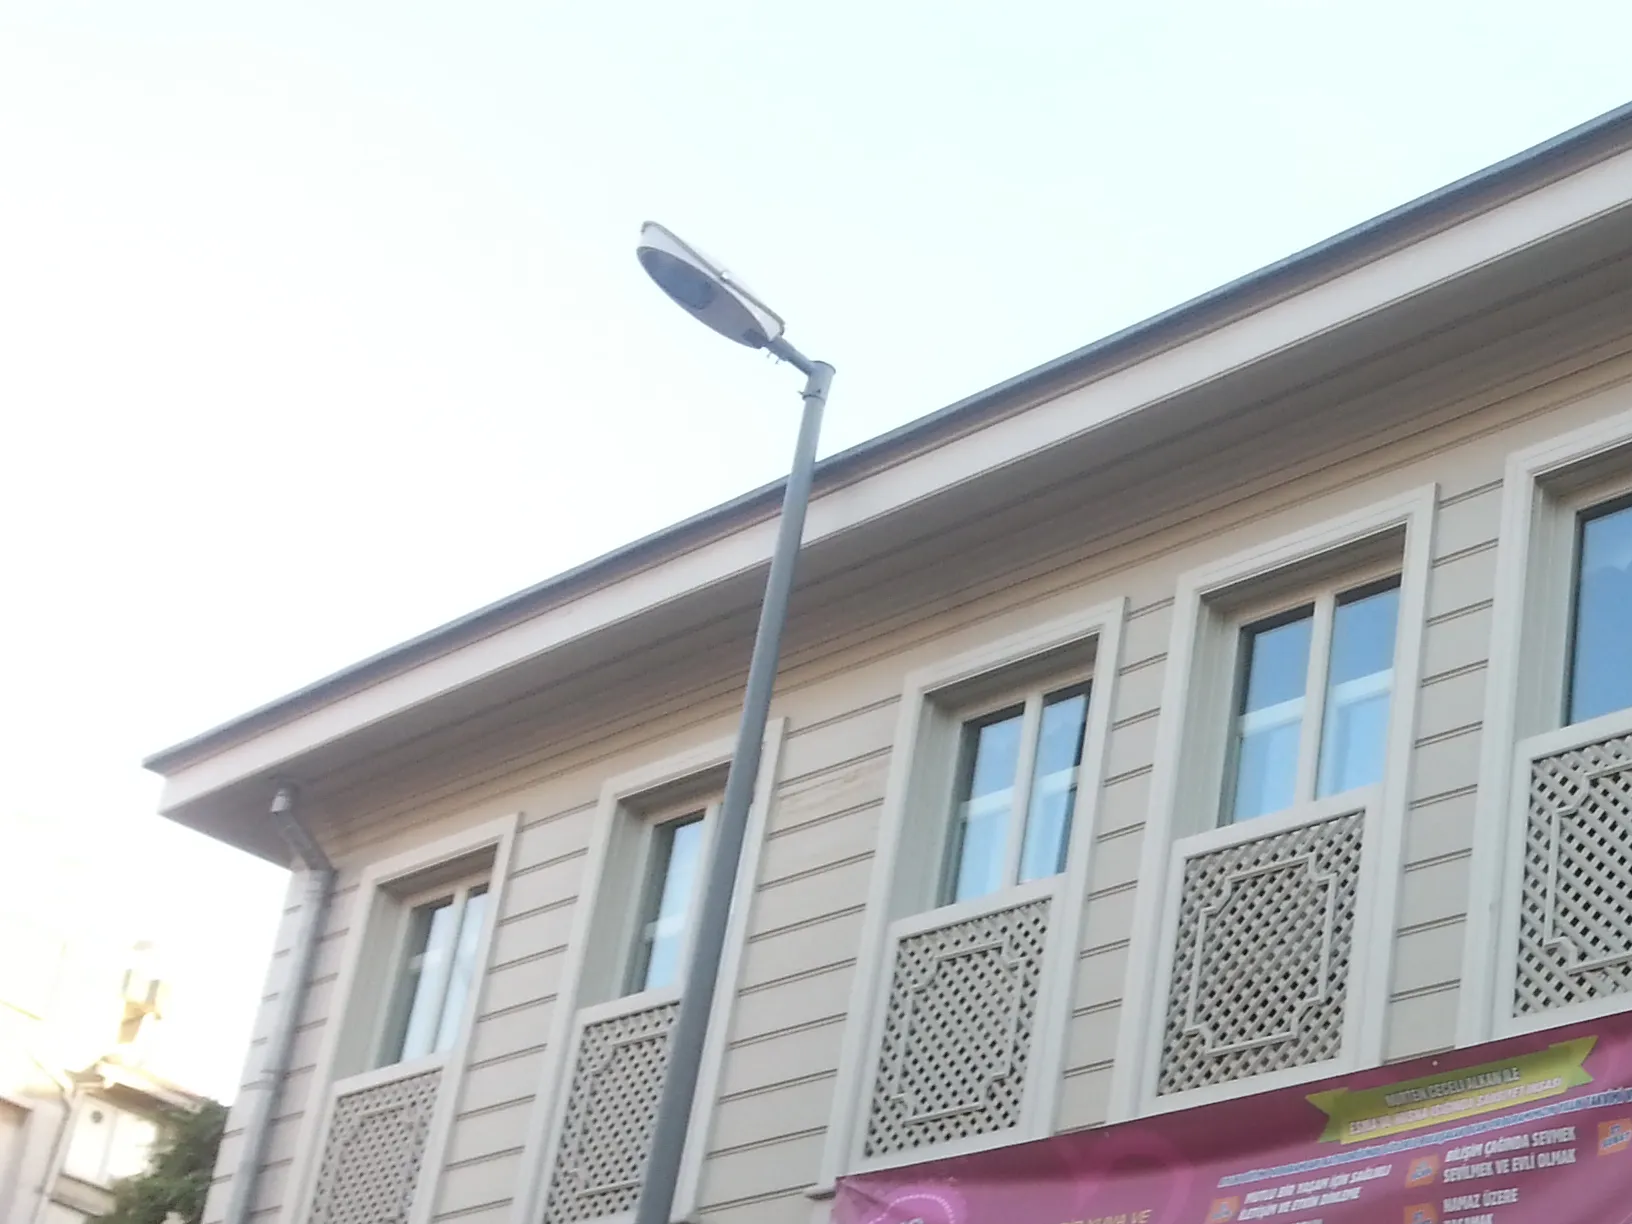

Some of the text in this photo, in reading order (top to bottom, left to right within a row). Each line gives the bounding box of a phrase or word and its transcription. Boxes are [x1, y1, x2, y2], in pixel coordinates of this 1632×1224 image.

[1531, 1126, 1576, 1147] SEVMEK
[1495, 1159, 1510, 1175] VE
[1537, 1147, 1576, 1168] OLMAK
[1130, 1208, 1152, 1224] VE
